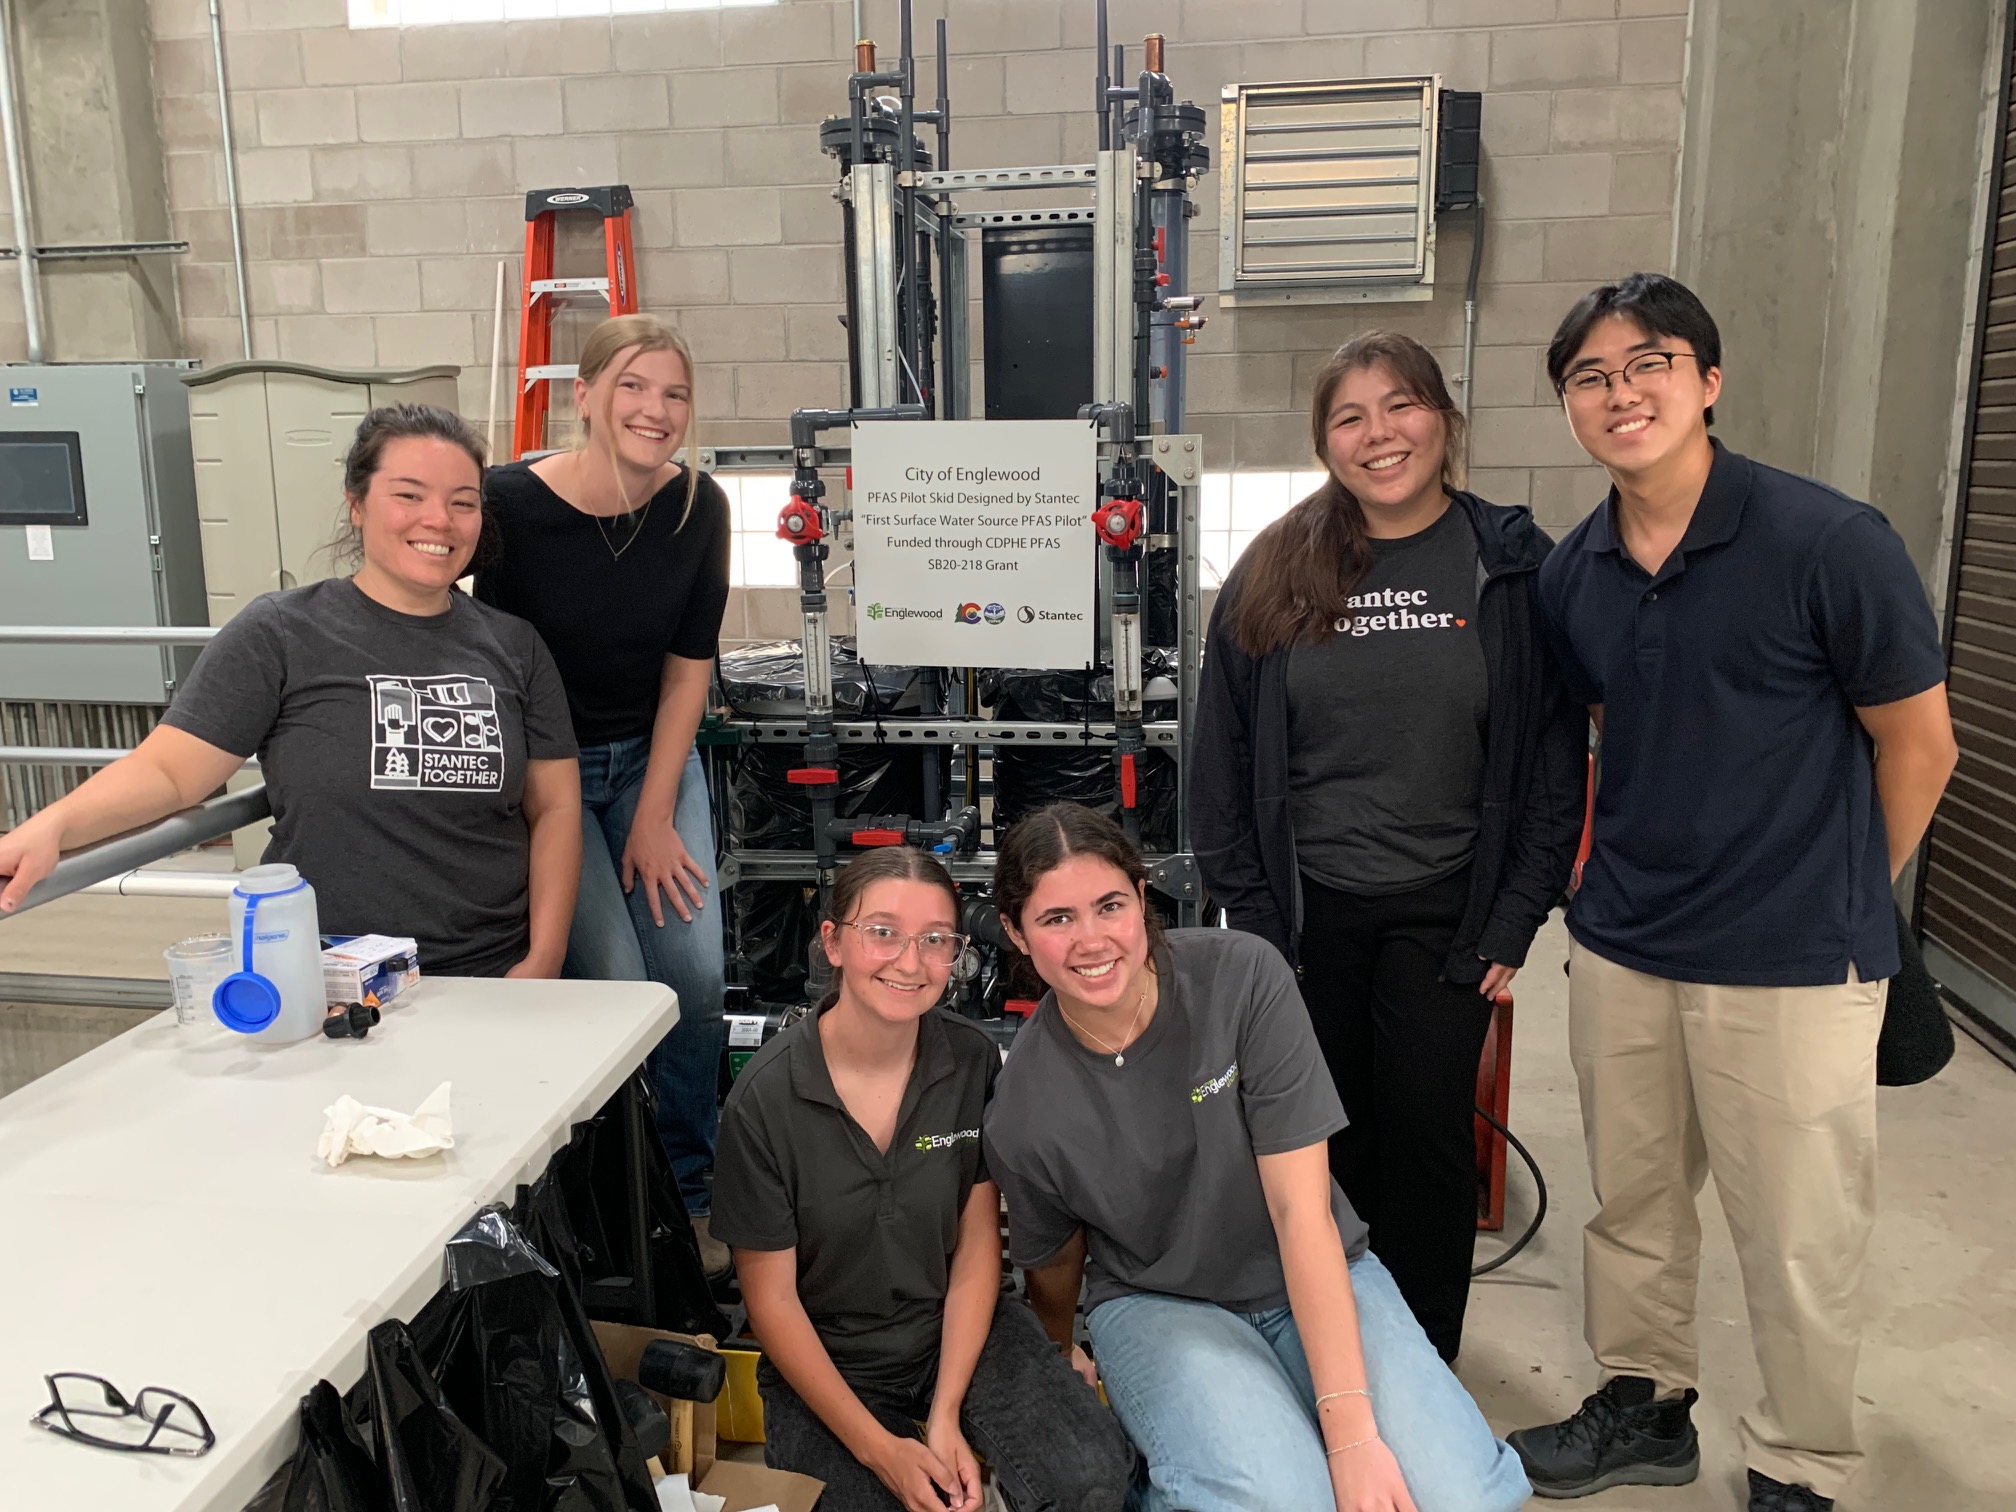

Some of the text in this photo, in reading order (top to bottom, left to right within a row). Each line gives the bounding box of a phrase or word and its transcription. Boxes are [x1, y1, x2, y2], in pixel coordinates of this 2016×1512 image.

[905, 467, 1039, 484] City of Englewood
[867, 492, 1079, 506] PFAS Pilot Skid Designed by Stantec
[893, 514, 936, 525] Surface
[939, 515, 974, 526] Water
[977, 515, 1018, 526] Source
[1021, 515, 1051, 526] PFAS
[887, 537, 1060, 551] Funded through CDPHE PFAS
[928, 559, 1018, 570] SB20-218 Grant
[1345, 588, 1428, 609] antec
[884, 608, 942, 619] Englewood
[1038, 611, 1082, 620] Stantec
[1333, 609, 1454, 637] ogether
[424, 753, 489, 769] STANTEC
[424, 769, 498, 785] TOGETHER
[931, 1128, 980, 1148] Englwood
